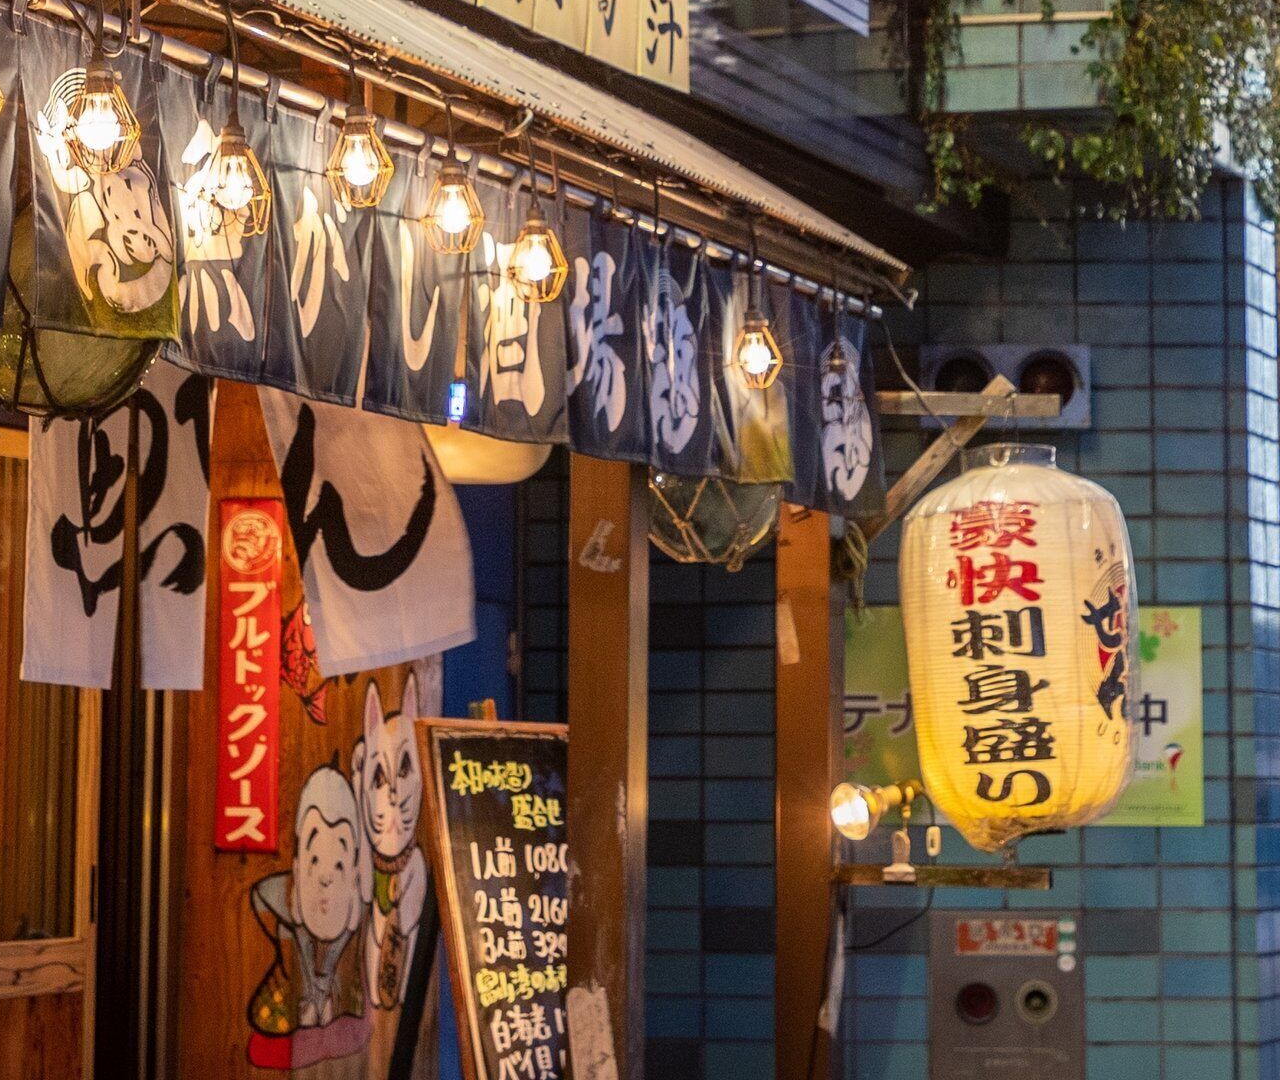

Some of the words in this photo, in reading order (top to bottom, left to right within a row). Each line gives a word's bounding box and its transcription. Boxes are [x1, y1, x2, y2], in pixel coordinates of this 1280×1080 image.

[224, 580, 276, 845] ブルドックソース
